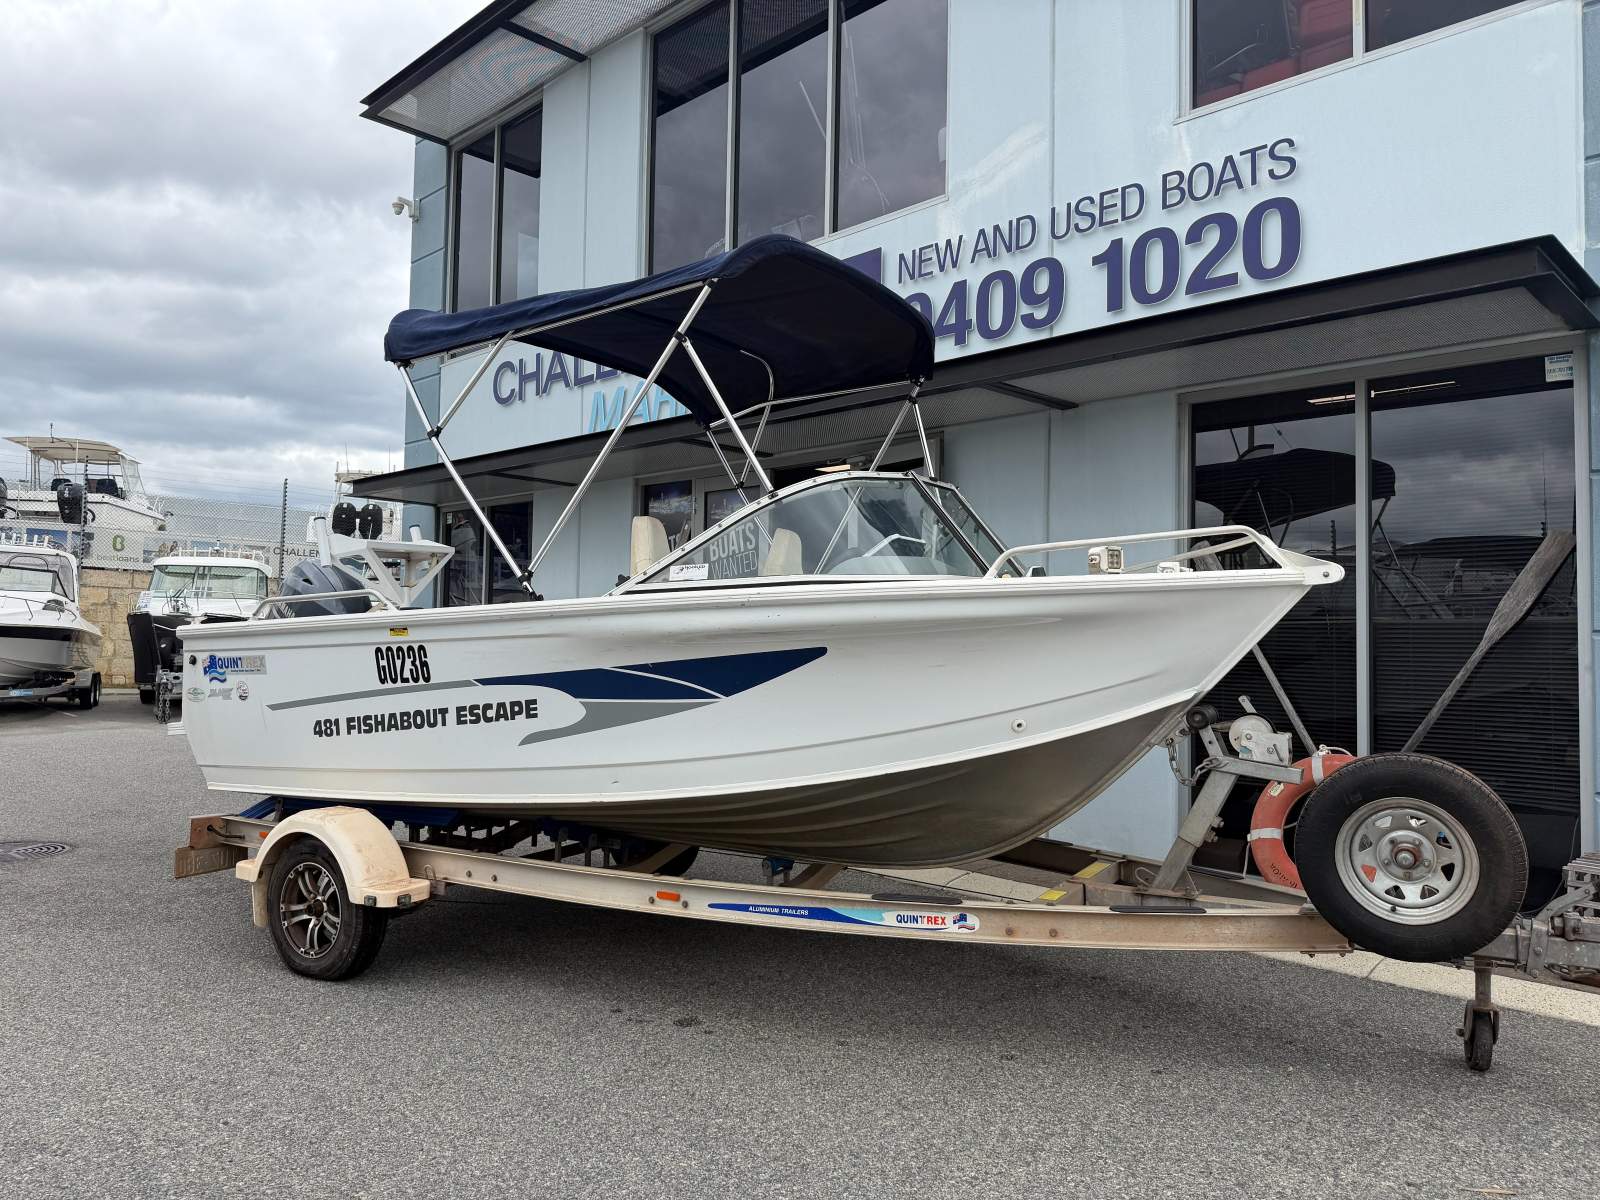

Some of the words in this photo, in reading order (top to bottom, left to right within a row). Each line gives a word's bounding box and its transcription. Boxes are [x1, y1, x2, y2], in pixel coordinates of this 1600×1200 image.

[899, 235, 963, 284] NEW
[971, 214, 1037, 264] AND
[1050, 182, 1145, 241] USED
[1162, 138, 1297, 211] BOATS
[1092, 197, 1302, 313] 1020
[711, 550, 758, 580] WANTED
[313, 718, 341, 738] 481
[346, 707, 449, 736] FISHABOUT
[456, 698, 538, 726] ESCAPE
[749, 905, 779, 914] ALUMINIUM
[781, 908, 809, 916] TRAILERS
[896, 913, 947, 926] QUINTREX
